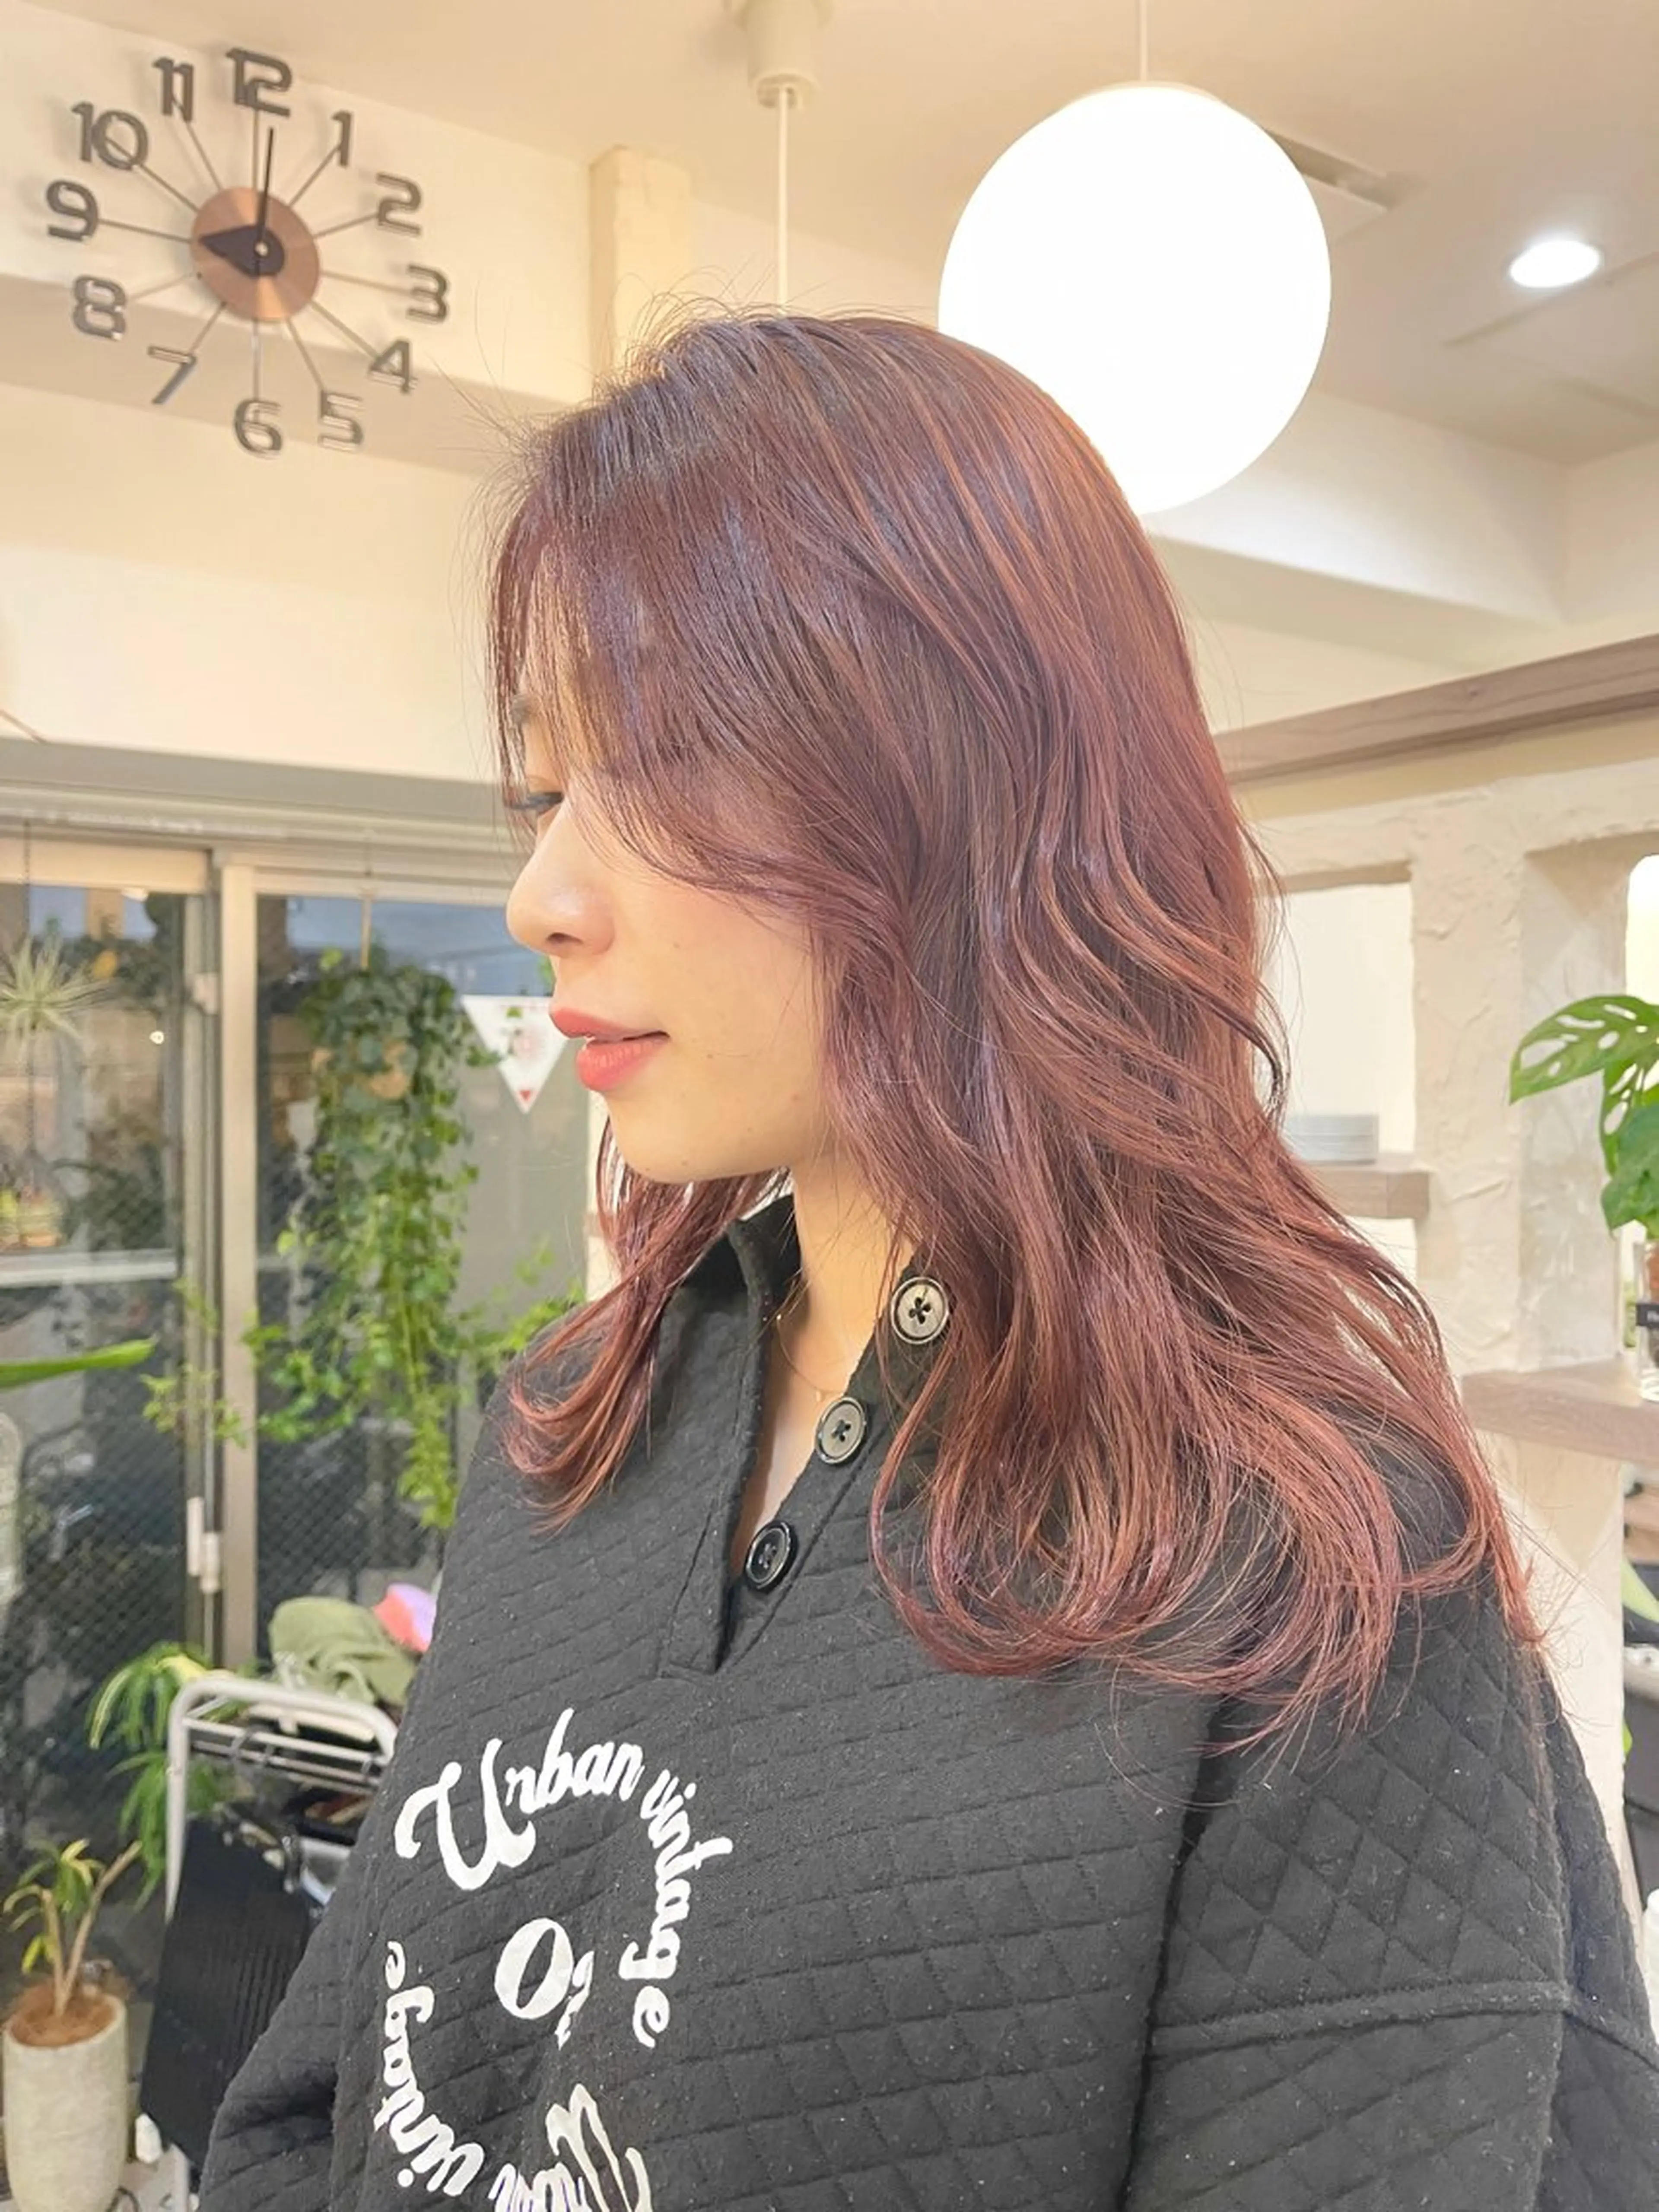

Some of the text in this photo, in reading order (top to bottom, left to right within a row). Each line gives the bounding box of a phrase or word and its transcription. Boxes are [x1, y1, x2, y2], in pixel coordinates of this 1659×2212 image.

[153, 57, 194, 122] 11
[226, 48, 292, 118] 12
[71, 101, 148, 171] 10
[332, 110, 352, 167] 1
[46, 179, 99, 242] 9
[376, 172, 422, 237] 2
[73, 275, 127, 340] 8
[406, 264, 449, 324] 3
[147, 346, 197, 405] 7
[368, 338, 419, 395] 4
[233, 397, 282, 458] 6
[318, 389, 364, 452] 5
[394, 1707, 733, 2049] Urban vintage
[374, 1941, 484, 2196] vintage
